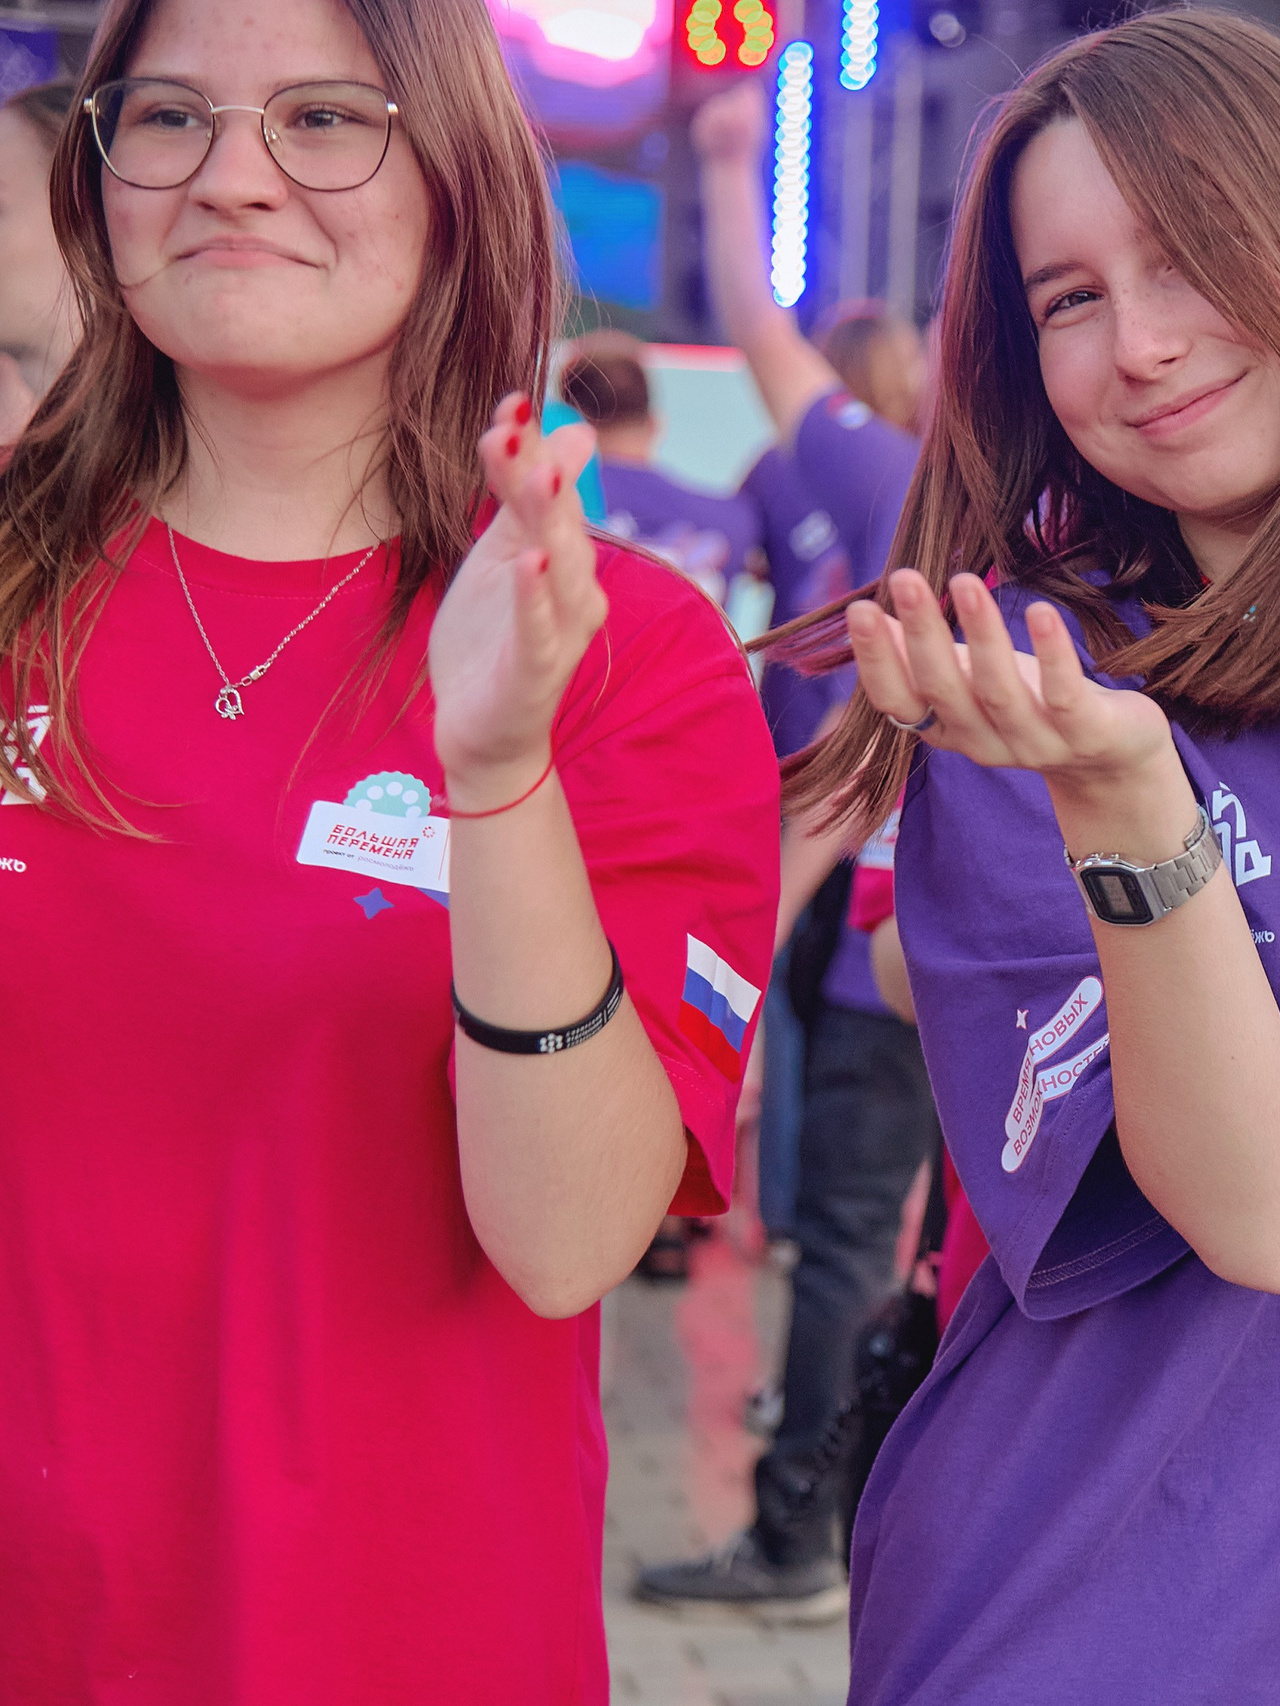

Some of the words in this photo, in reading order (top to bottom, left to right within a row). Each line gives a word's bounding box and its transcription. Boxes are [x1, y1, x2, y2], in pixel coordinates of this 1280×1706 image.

[326, 834, 415, 860] ПЕРЕМЕНА
[333, 824, 420, 849] БОЛЬШАЯ
[1012, 1056, 1032, 1124] ВРЕМЯ
[1029, 992, 1089, 1057] НОВЫХ
[1013, 1037, 1110, 1156] ВОЗМОЖНОСТ
